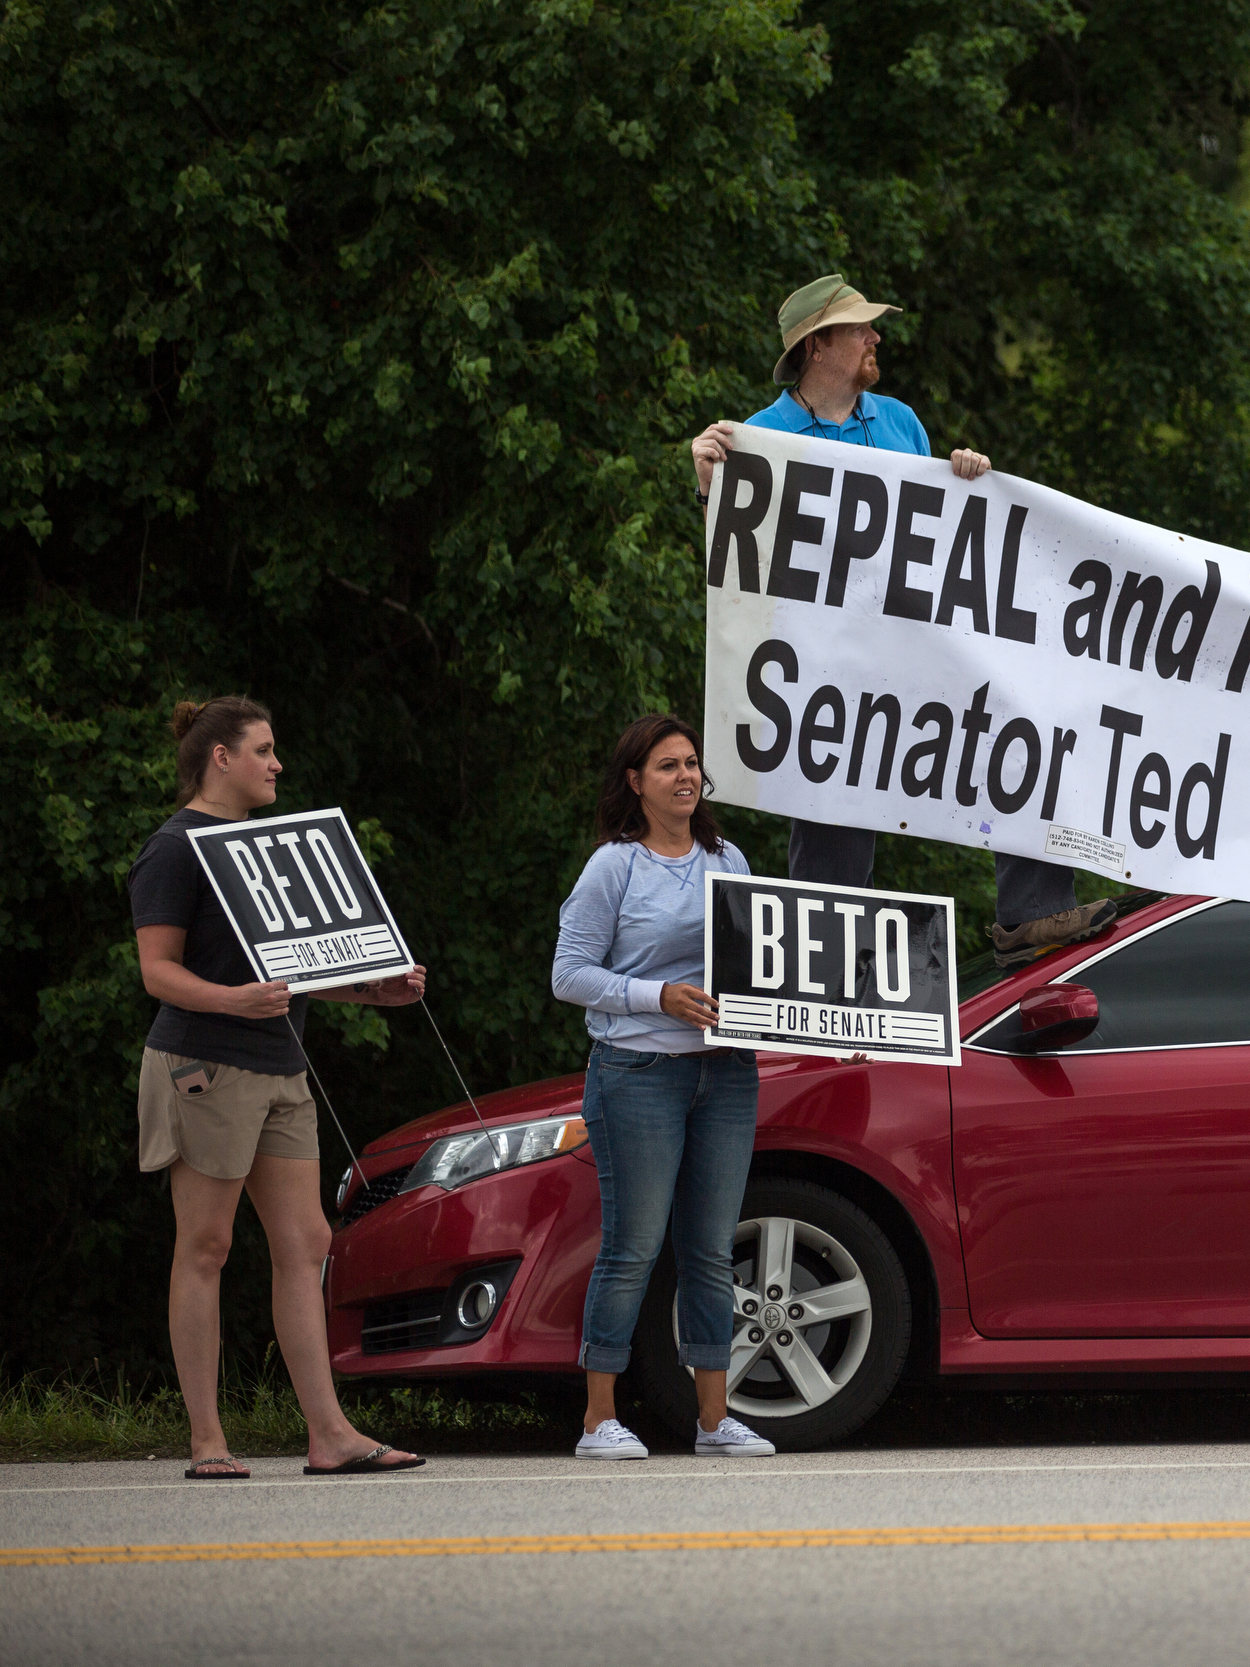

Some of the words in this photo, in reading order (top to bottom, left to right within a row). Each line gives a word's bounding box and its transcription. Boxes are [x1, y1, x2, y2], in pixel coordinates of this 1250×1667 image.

[707, 450, 1038, 645] REPEAL
[1062, 558, 1222, 683] and
[735, 638, 1078, 822] Senator
[1099, 704, 1232, 861] Ted
[224, 827, 363, 933] BETO
[1070, 843, 1093, 854] CANDIDATE
[1101, 847, 1124, 859] AUTHORIZED
[291, 941, 321, 969] FOR
[317, 933, 368, 965] SENATE
[751, 892, 911, 1003] BETO
[776, 1003, 810, 1032] FOR
[819, 1008, 887, 1039] SENATE
